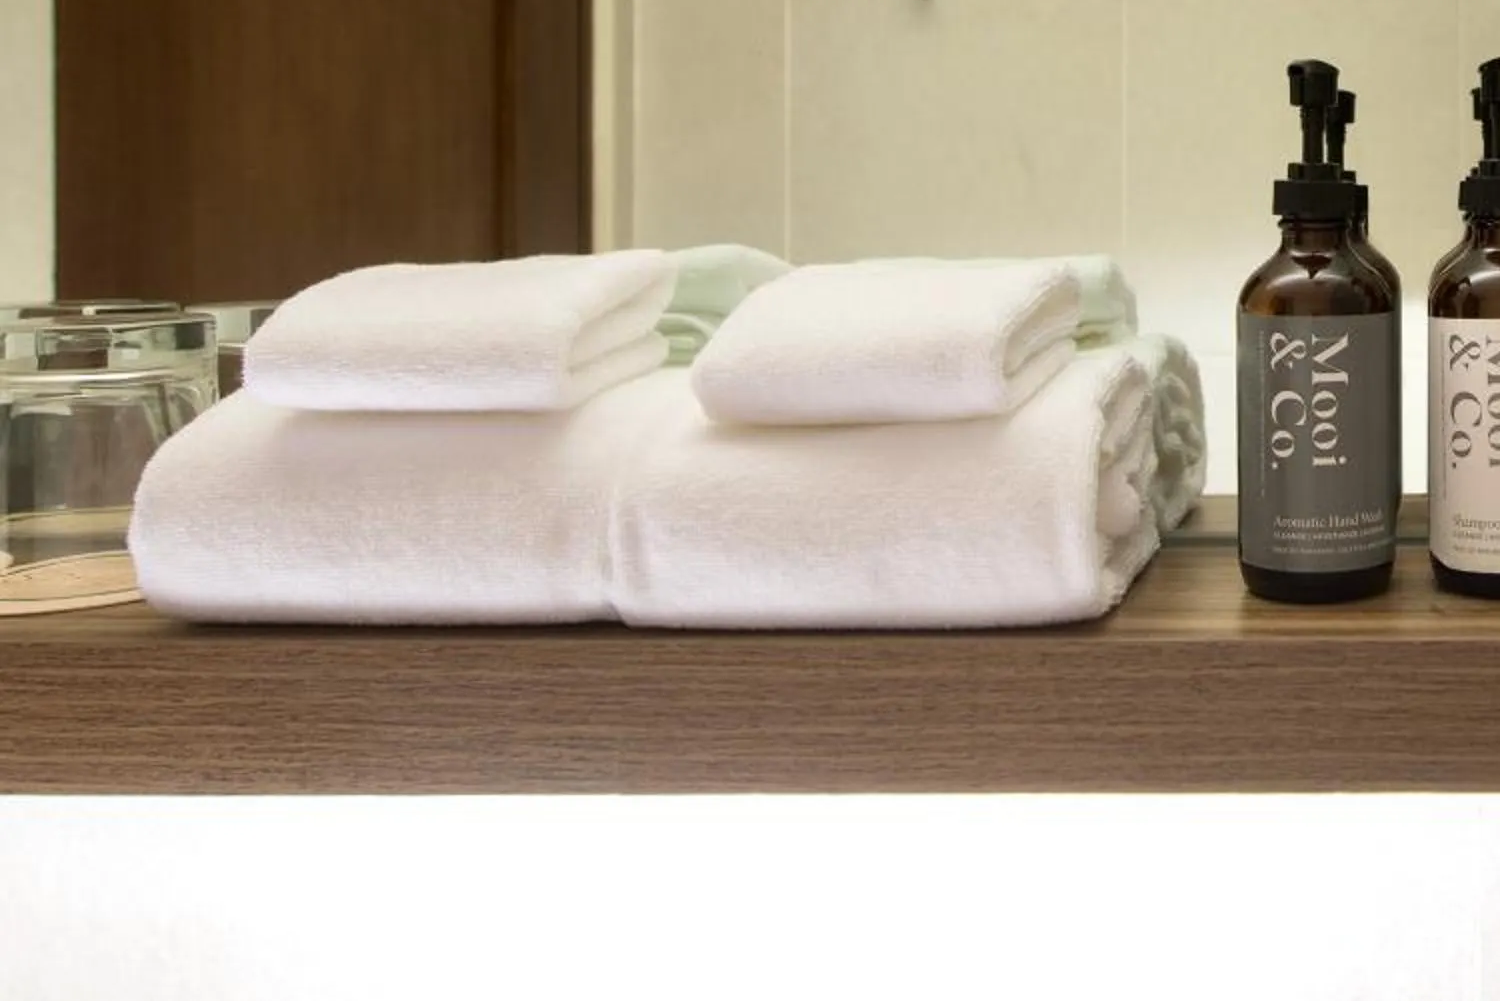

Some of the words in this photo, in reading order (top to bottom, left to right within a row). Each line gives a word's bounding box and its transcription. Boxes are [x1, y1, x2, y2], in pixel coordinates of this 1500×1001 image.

[1269, 332, 1307, 371] &
[1449, 334, 1481, 371] &
[1271, 390, 1308, 470] Co.
[1311, 332, 1349, 467] Mooi
[1450, 391, 1483, 470] Co.
